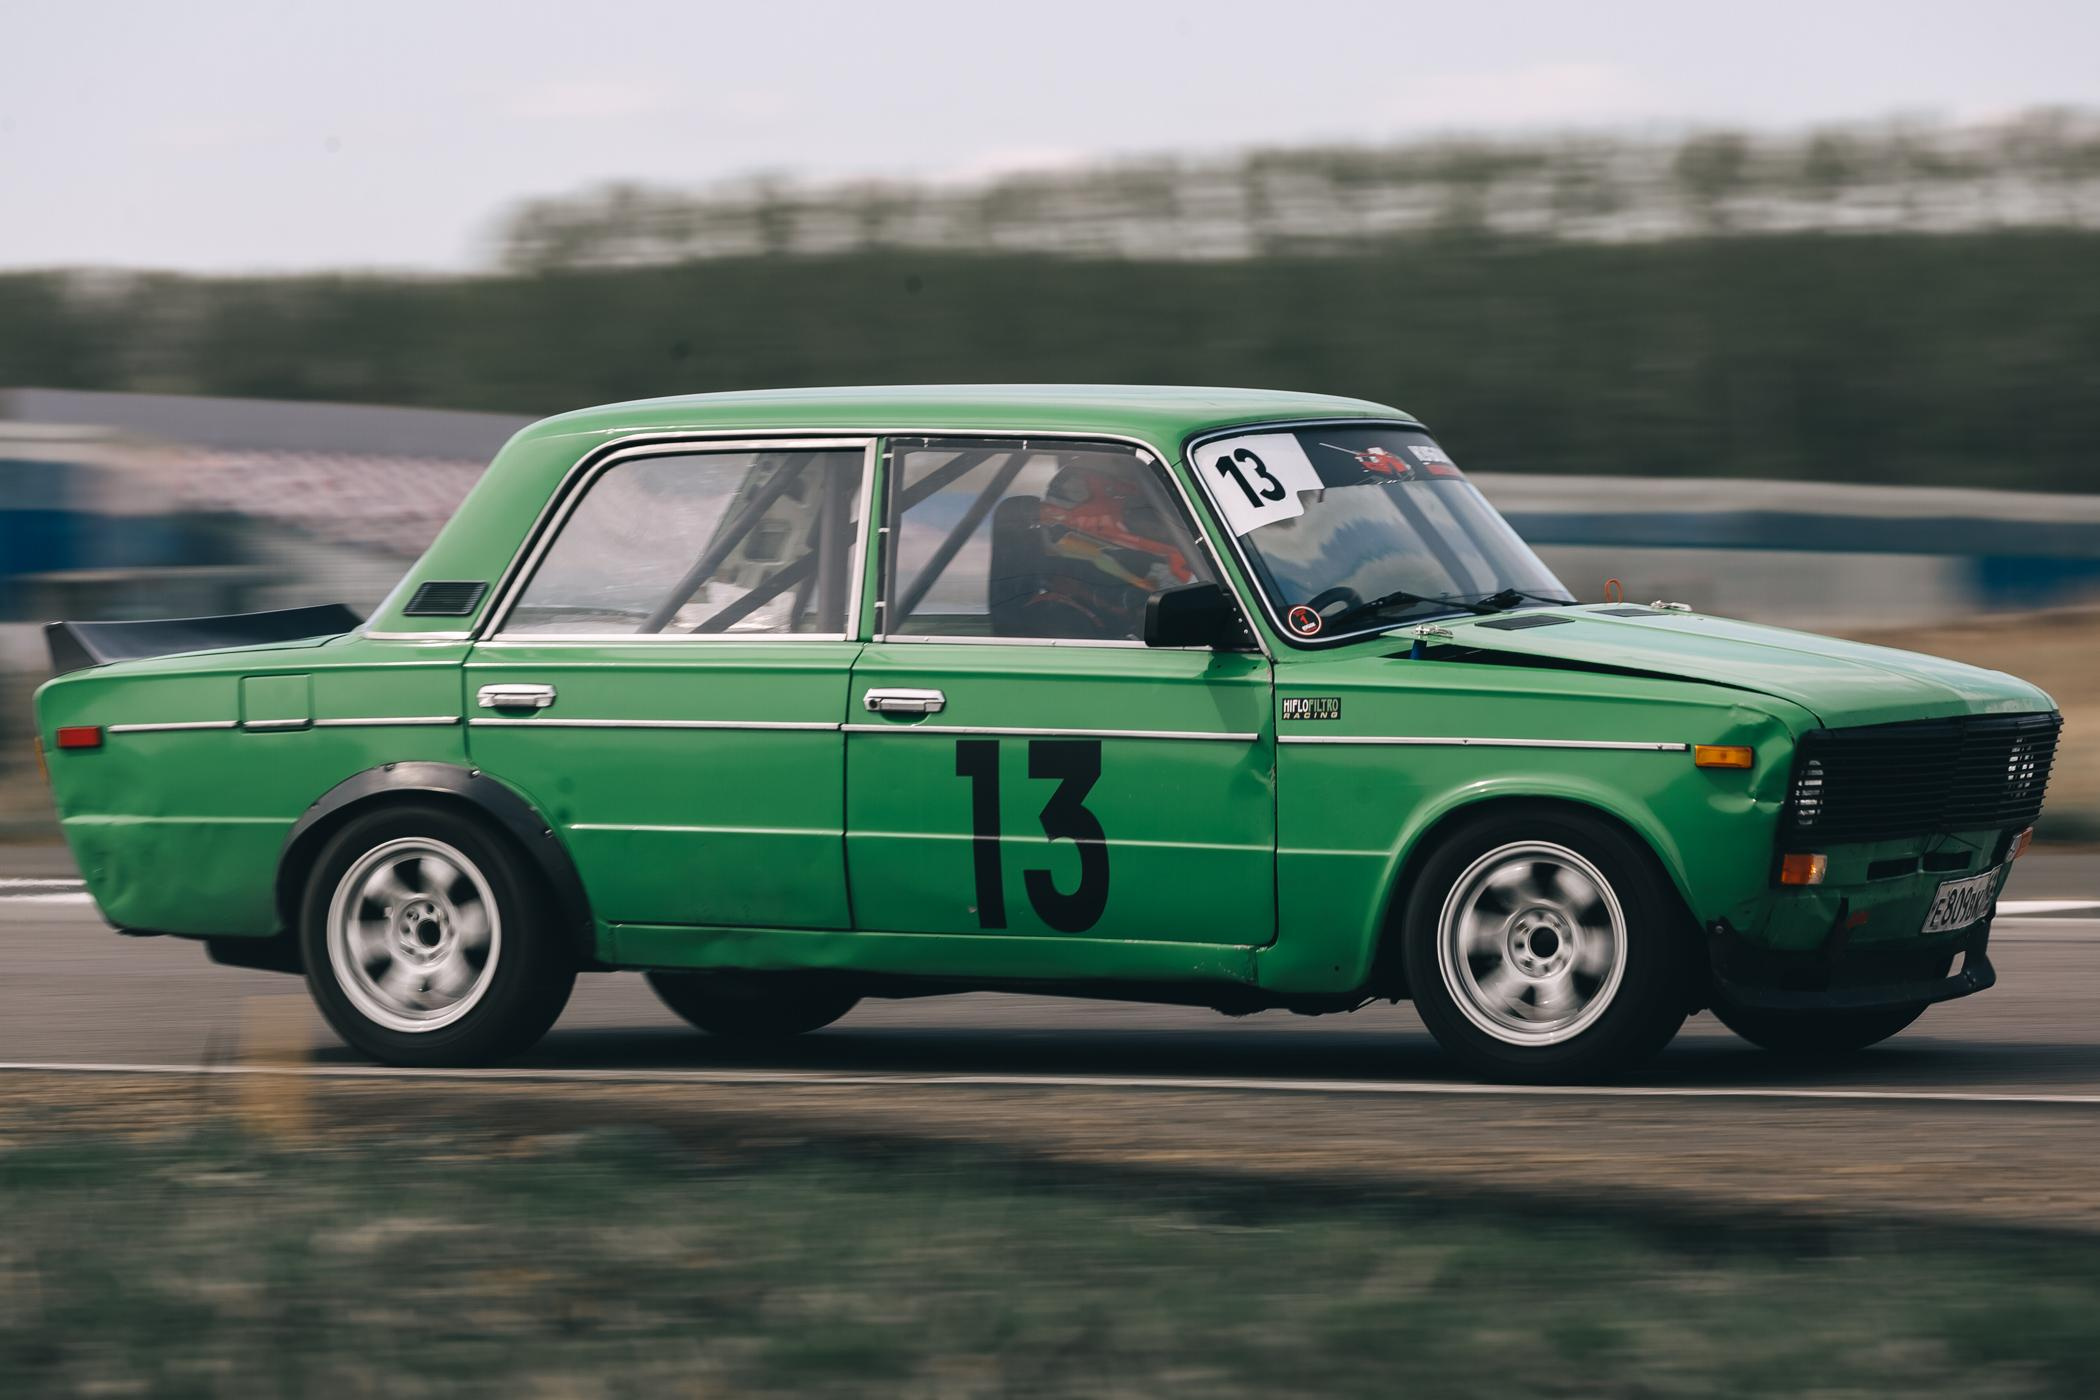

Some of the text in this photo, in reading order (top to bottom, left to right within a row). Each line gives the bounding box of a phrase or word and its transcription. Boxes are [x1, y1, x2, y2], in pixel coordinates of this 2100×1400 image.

[1215, 448, 1286, 508] 13
[1283, 699, 1339, 712] HIFLOFILTRO
[956, 740, 1110, 934] 13
